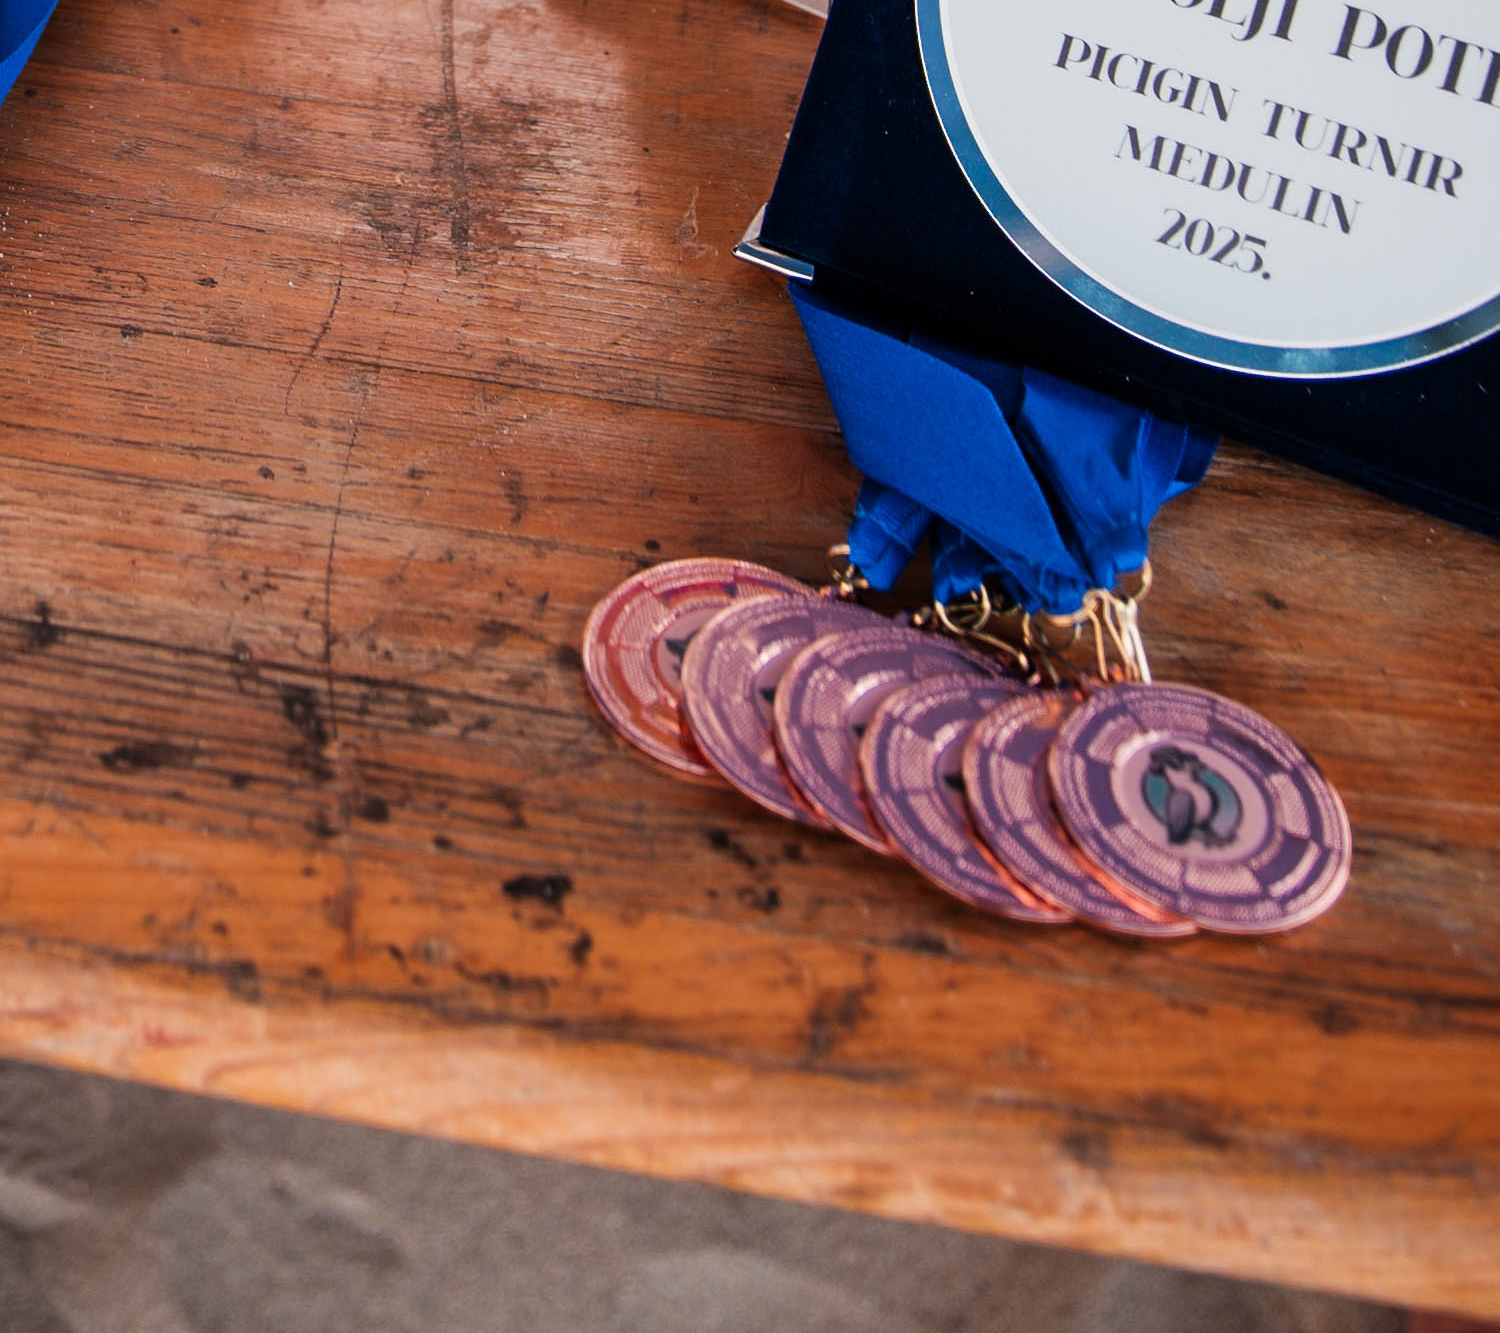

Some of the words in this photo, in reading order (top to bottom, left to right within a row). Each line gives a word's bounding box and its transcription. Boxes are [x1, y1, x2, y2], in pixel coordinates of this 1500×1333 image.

[1054, 31, 1238, 122] PICIGIN
[1262, 99, 1465, 199] TURNIR
[1115, 124, 1362, 237] MEDULIN
[1154, 206, 1274, 283] 2025.
